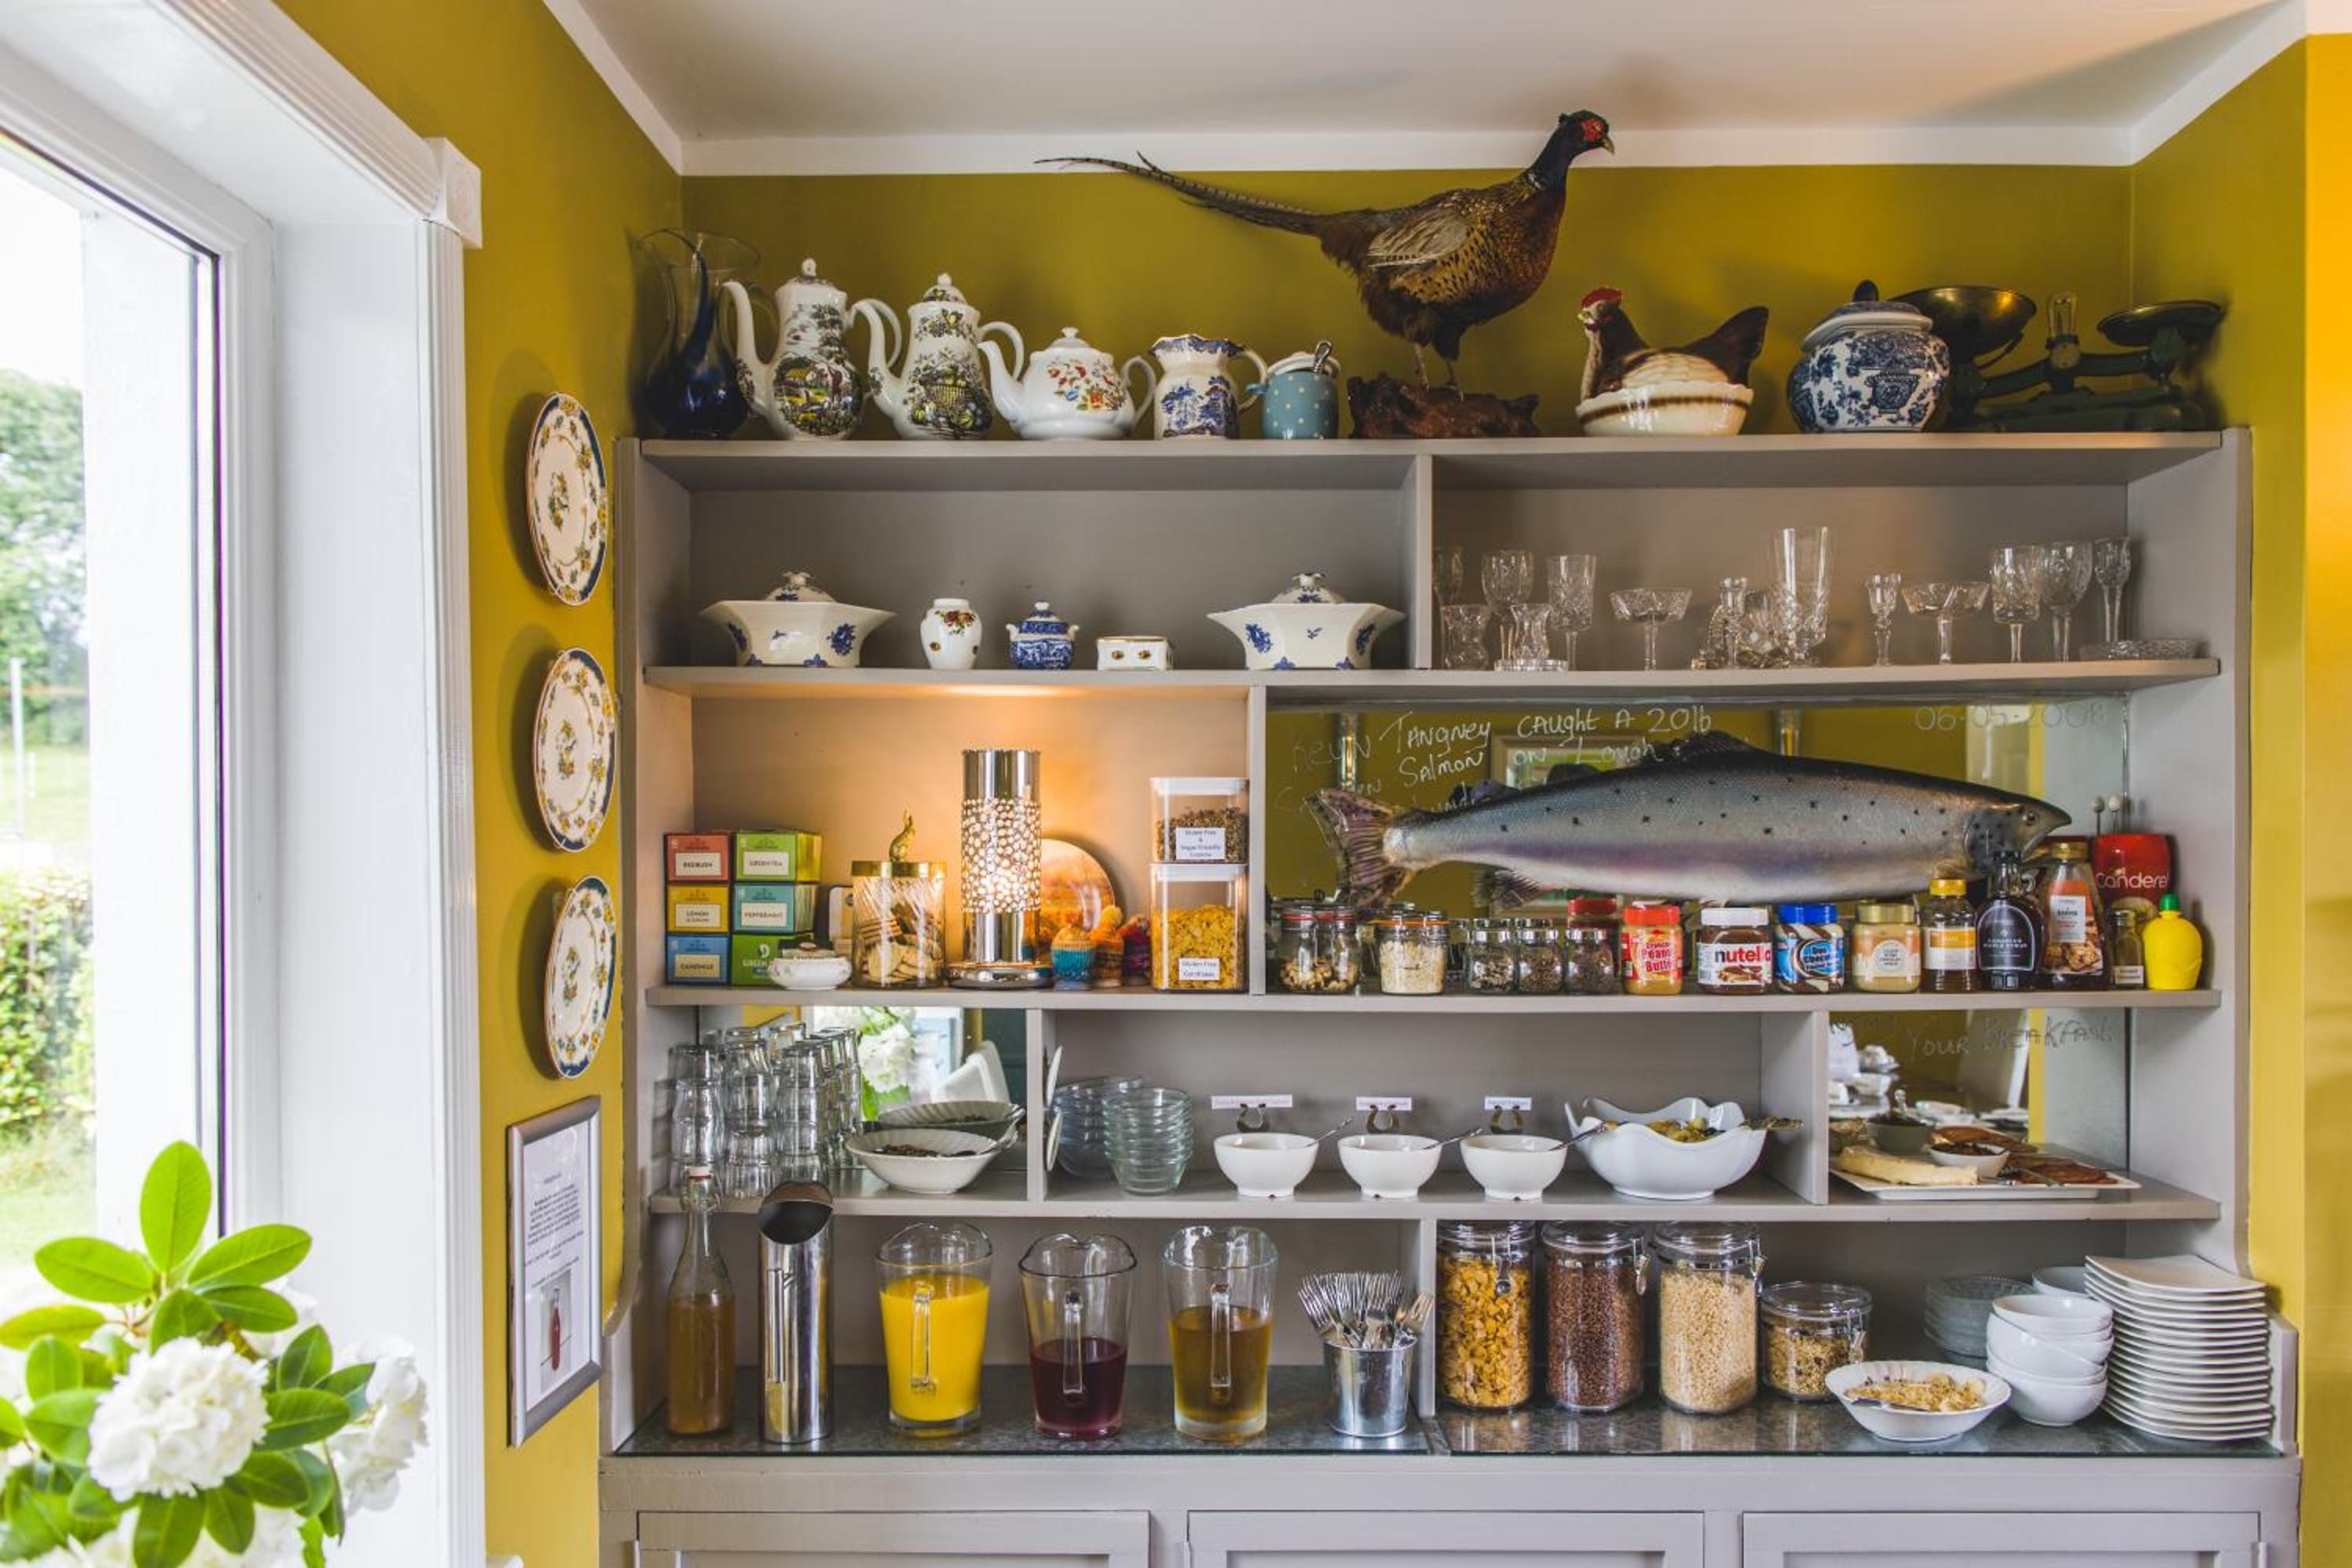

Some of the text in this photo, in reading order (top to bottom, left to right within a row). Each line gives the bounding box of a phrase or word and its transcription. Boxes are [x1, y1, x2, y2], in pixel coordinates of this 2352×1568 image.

[1615, 709, 1639, 729] A
[1646, 705, 1712, 733] 20lb
[1715, 946, 1771, 963] nutela
